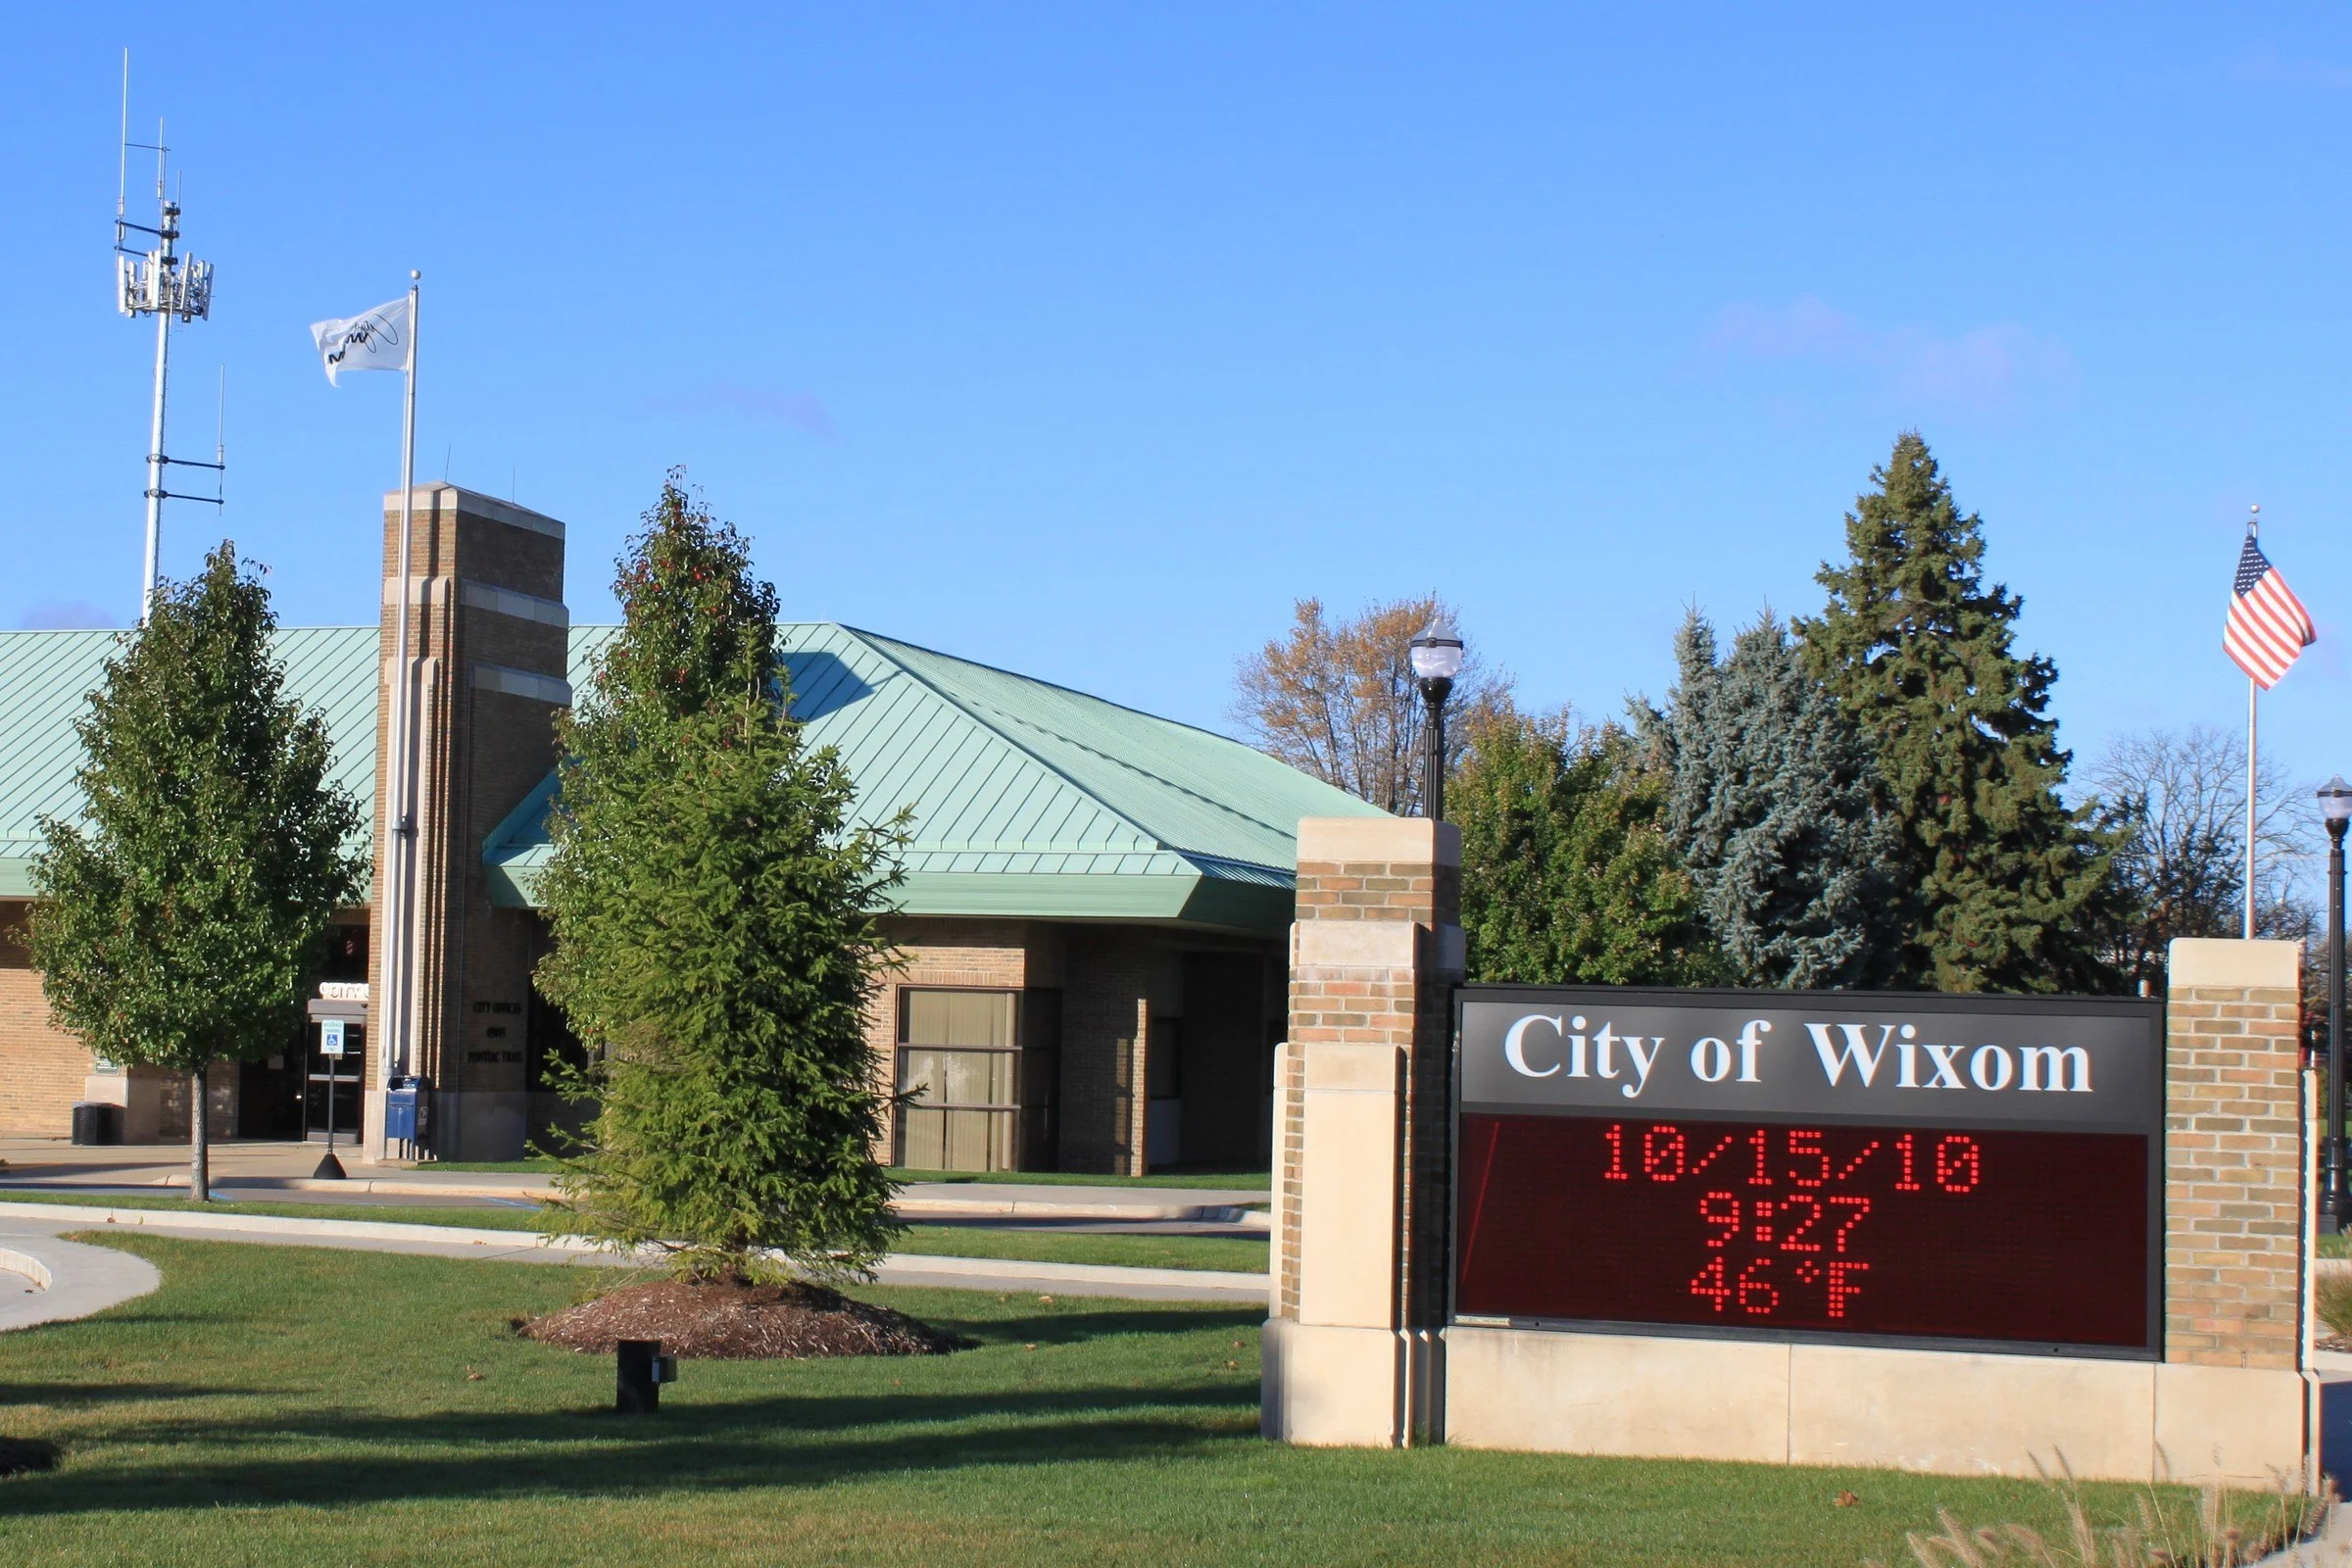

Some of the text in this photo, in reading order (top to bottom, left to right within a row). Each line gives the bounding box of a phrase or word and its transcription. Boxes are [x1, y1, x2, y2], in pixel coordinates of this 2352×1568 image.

[1504, 1013, 2094, 1099] City of Wixom
[1604, 1124, 1980, 1193] 10/15/10
[1699, 1192, 1871, 1252] 9:27
[1690, 1256, 1870, 1317] 46°F
